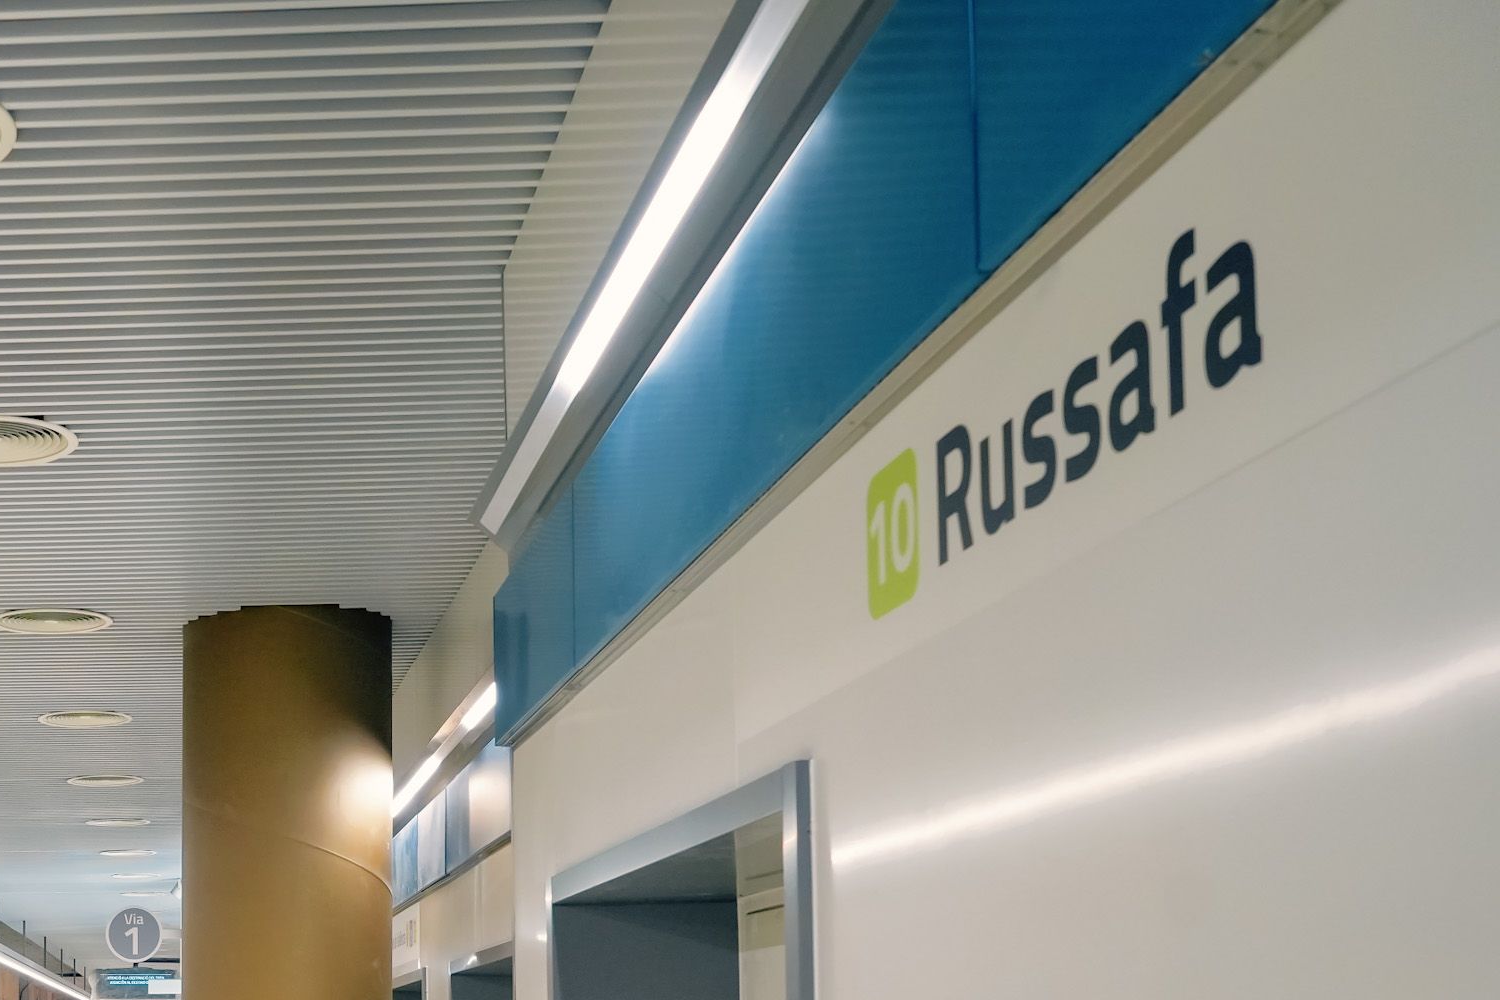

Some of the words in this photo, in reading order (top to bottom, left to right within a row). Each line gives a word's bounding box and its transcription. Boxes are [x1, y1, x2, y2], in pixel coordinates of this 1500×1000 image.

[869, 481, 915, 585] 10
[936, 228, 1263, 567] Russafa
[124, 913, 144, 925] Via
[124, 927, 139, 955] 1
